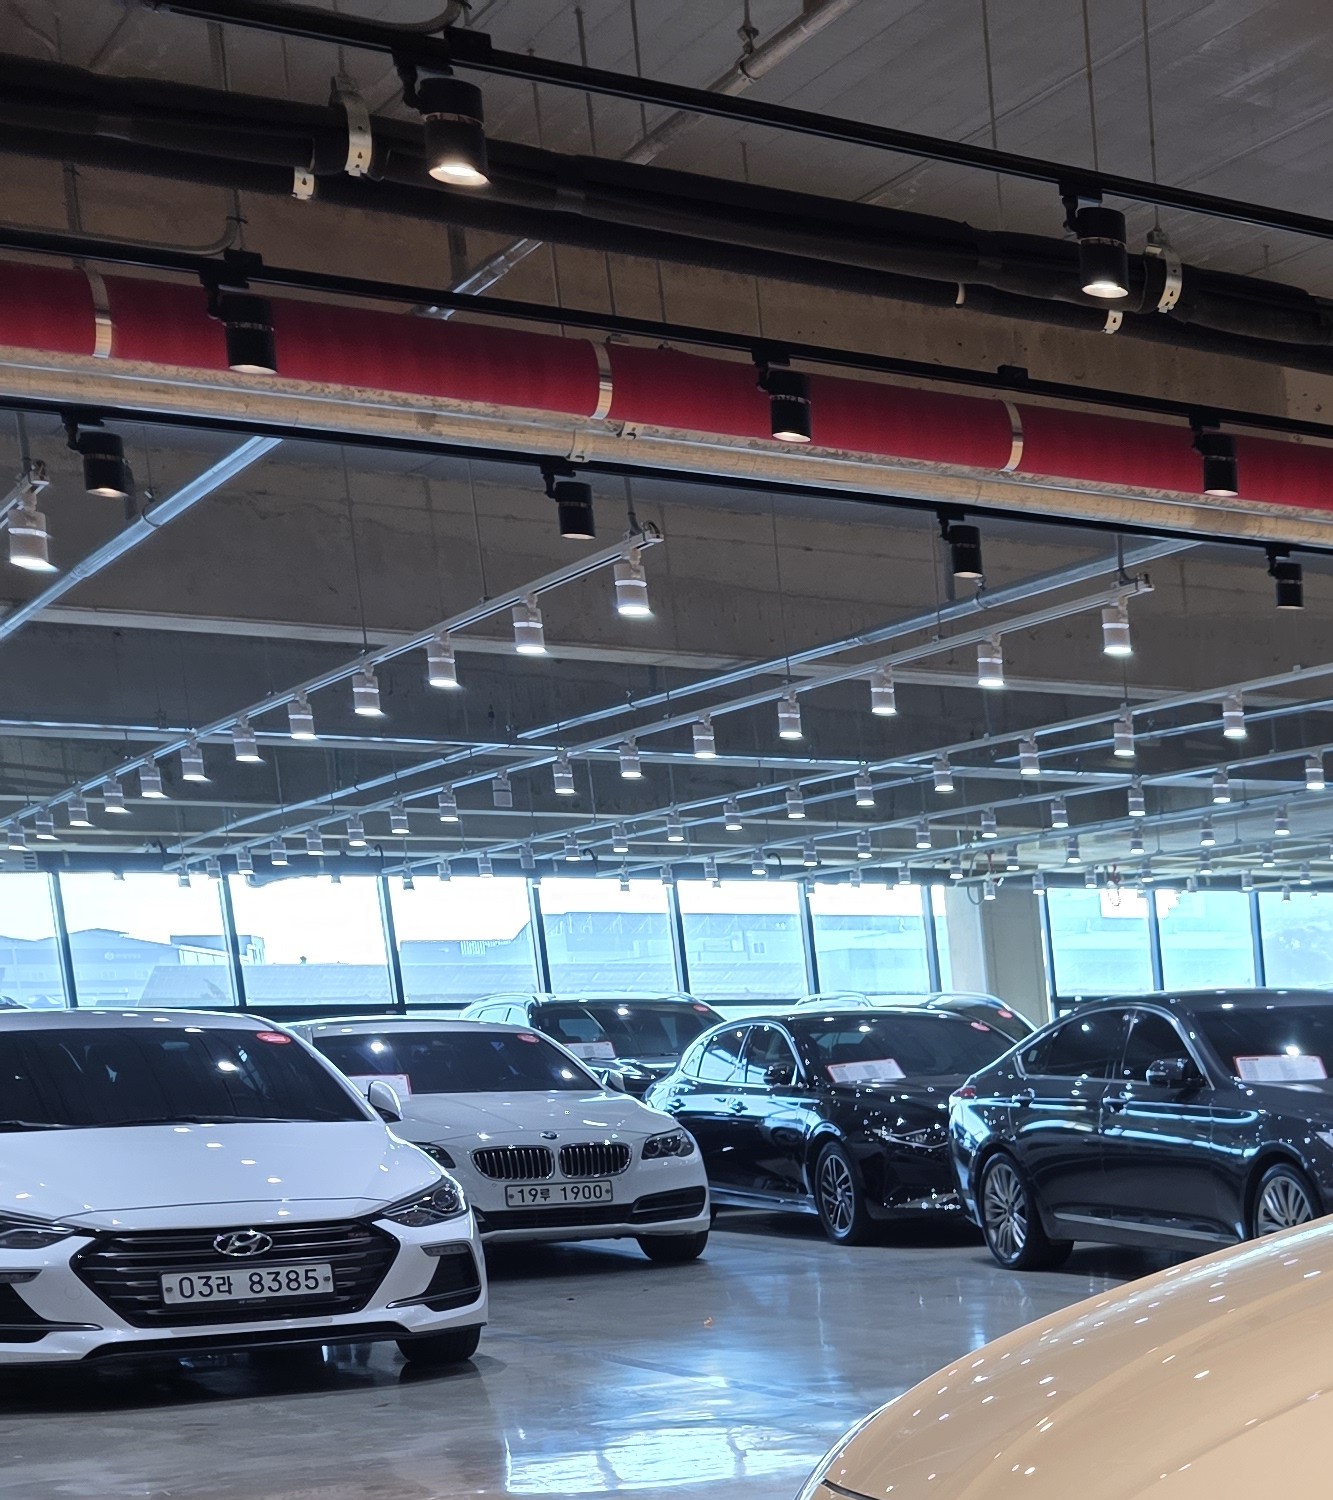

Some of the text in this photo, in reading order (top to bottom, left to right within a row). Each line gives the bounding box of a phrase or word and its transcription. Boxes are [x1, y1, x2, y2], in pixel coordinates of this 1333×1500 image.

[560, 1184, 603, 1201] 1900
[178, 1268, 320, 1299] 03라 8385
